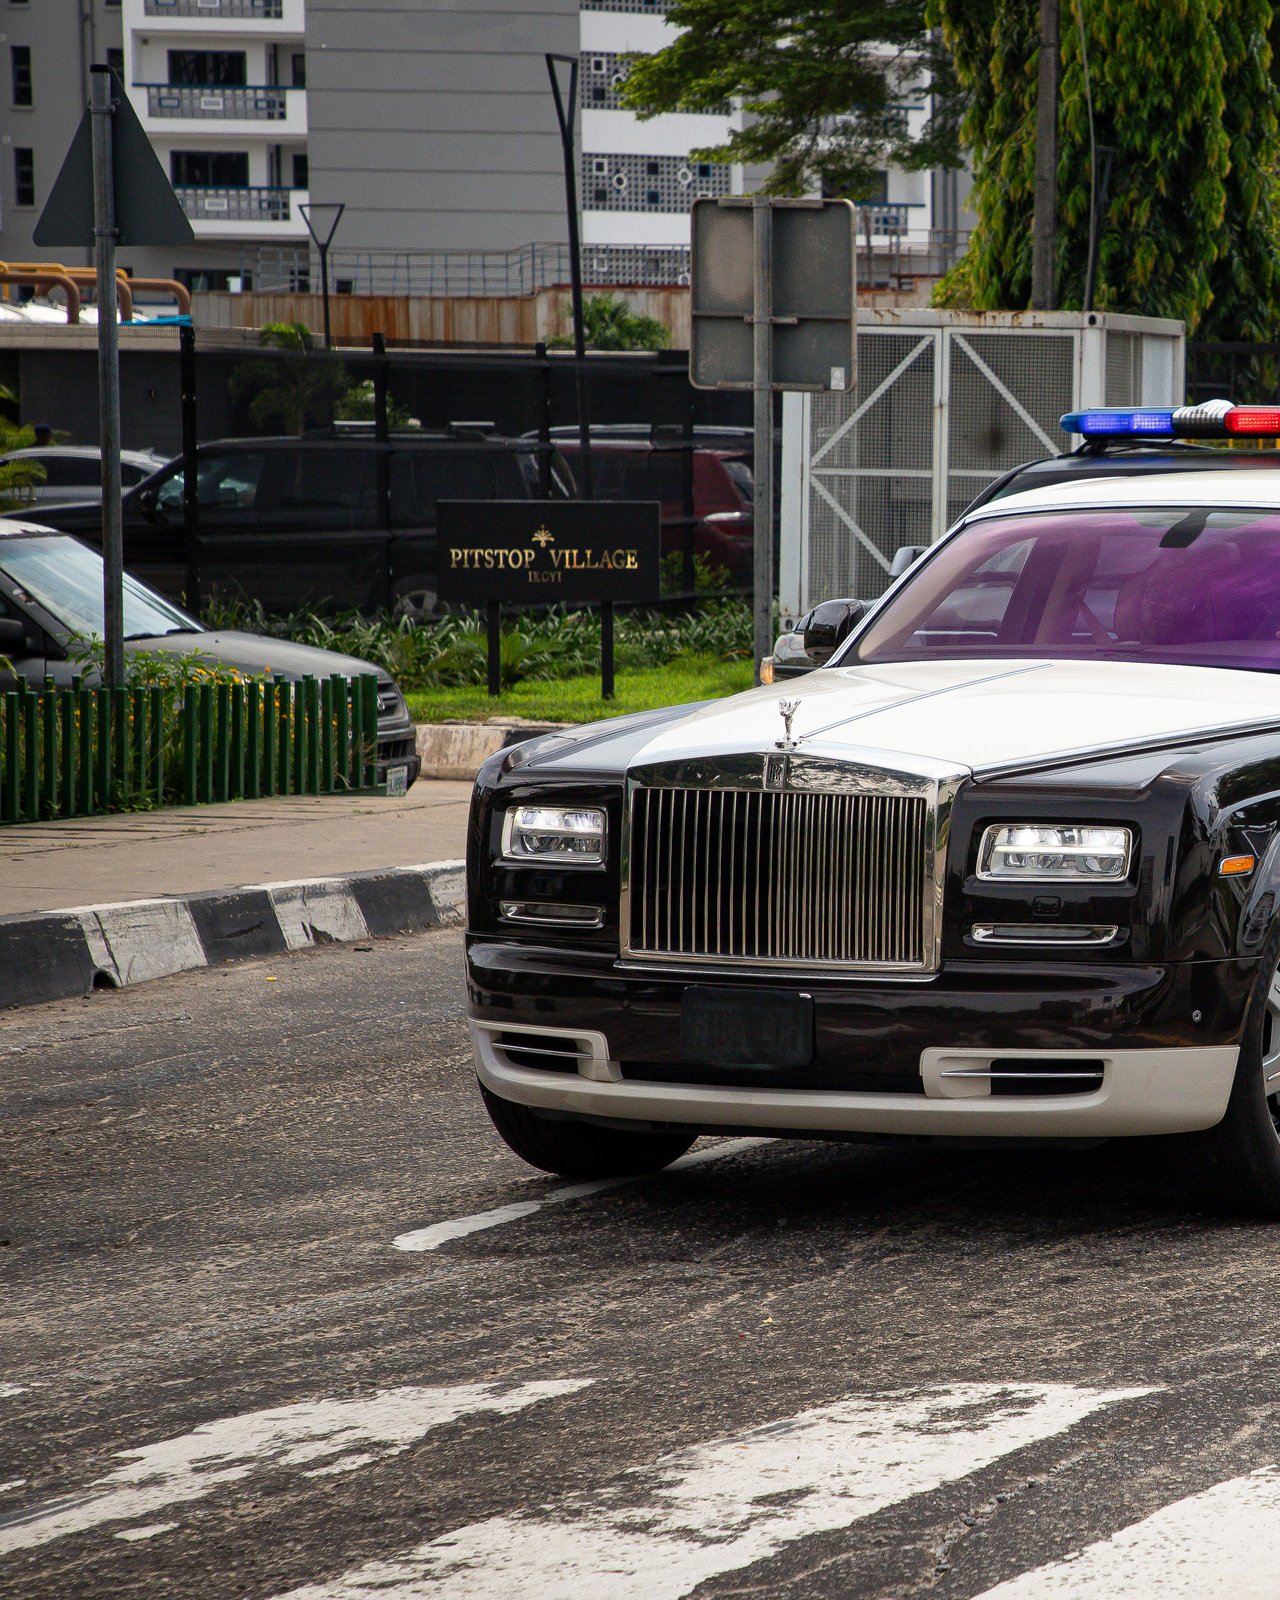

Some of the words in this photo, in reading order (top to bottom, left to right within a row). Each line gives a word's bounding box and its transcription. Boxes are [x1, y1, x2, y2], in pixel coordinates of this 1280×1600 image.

[450, 549, 536, 569] PITSTOP
[550, 549, 639, 570] VILLAGE
[528, 571, 562, 583] IKOYI
